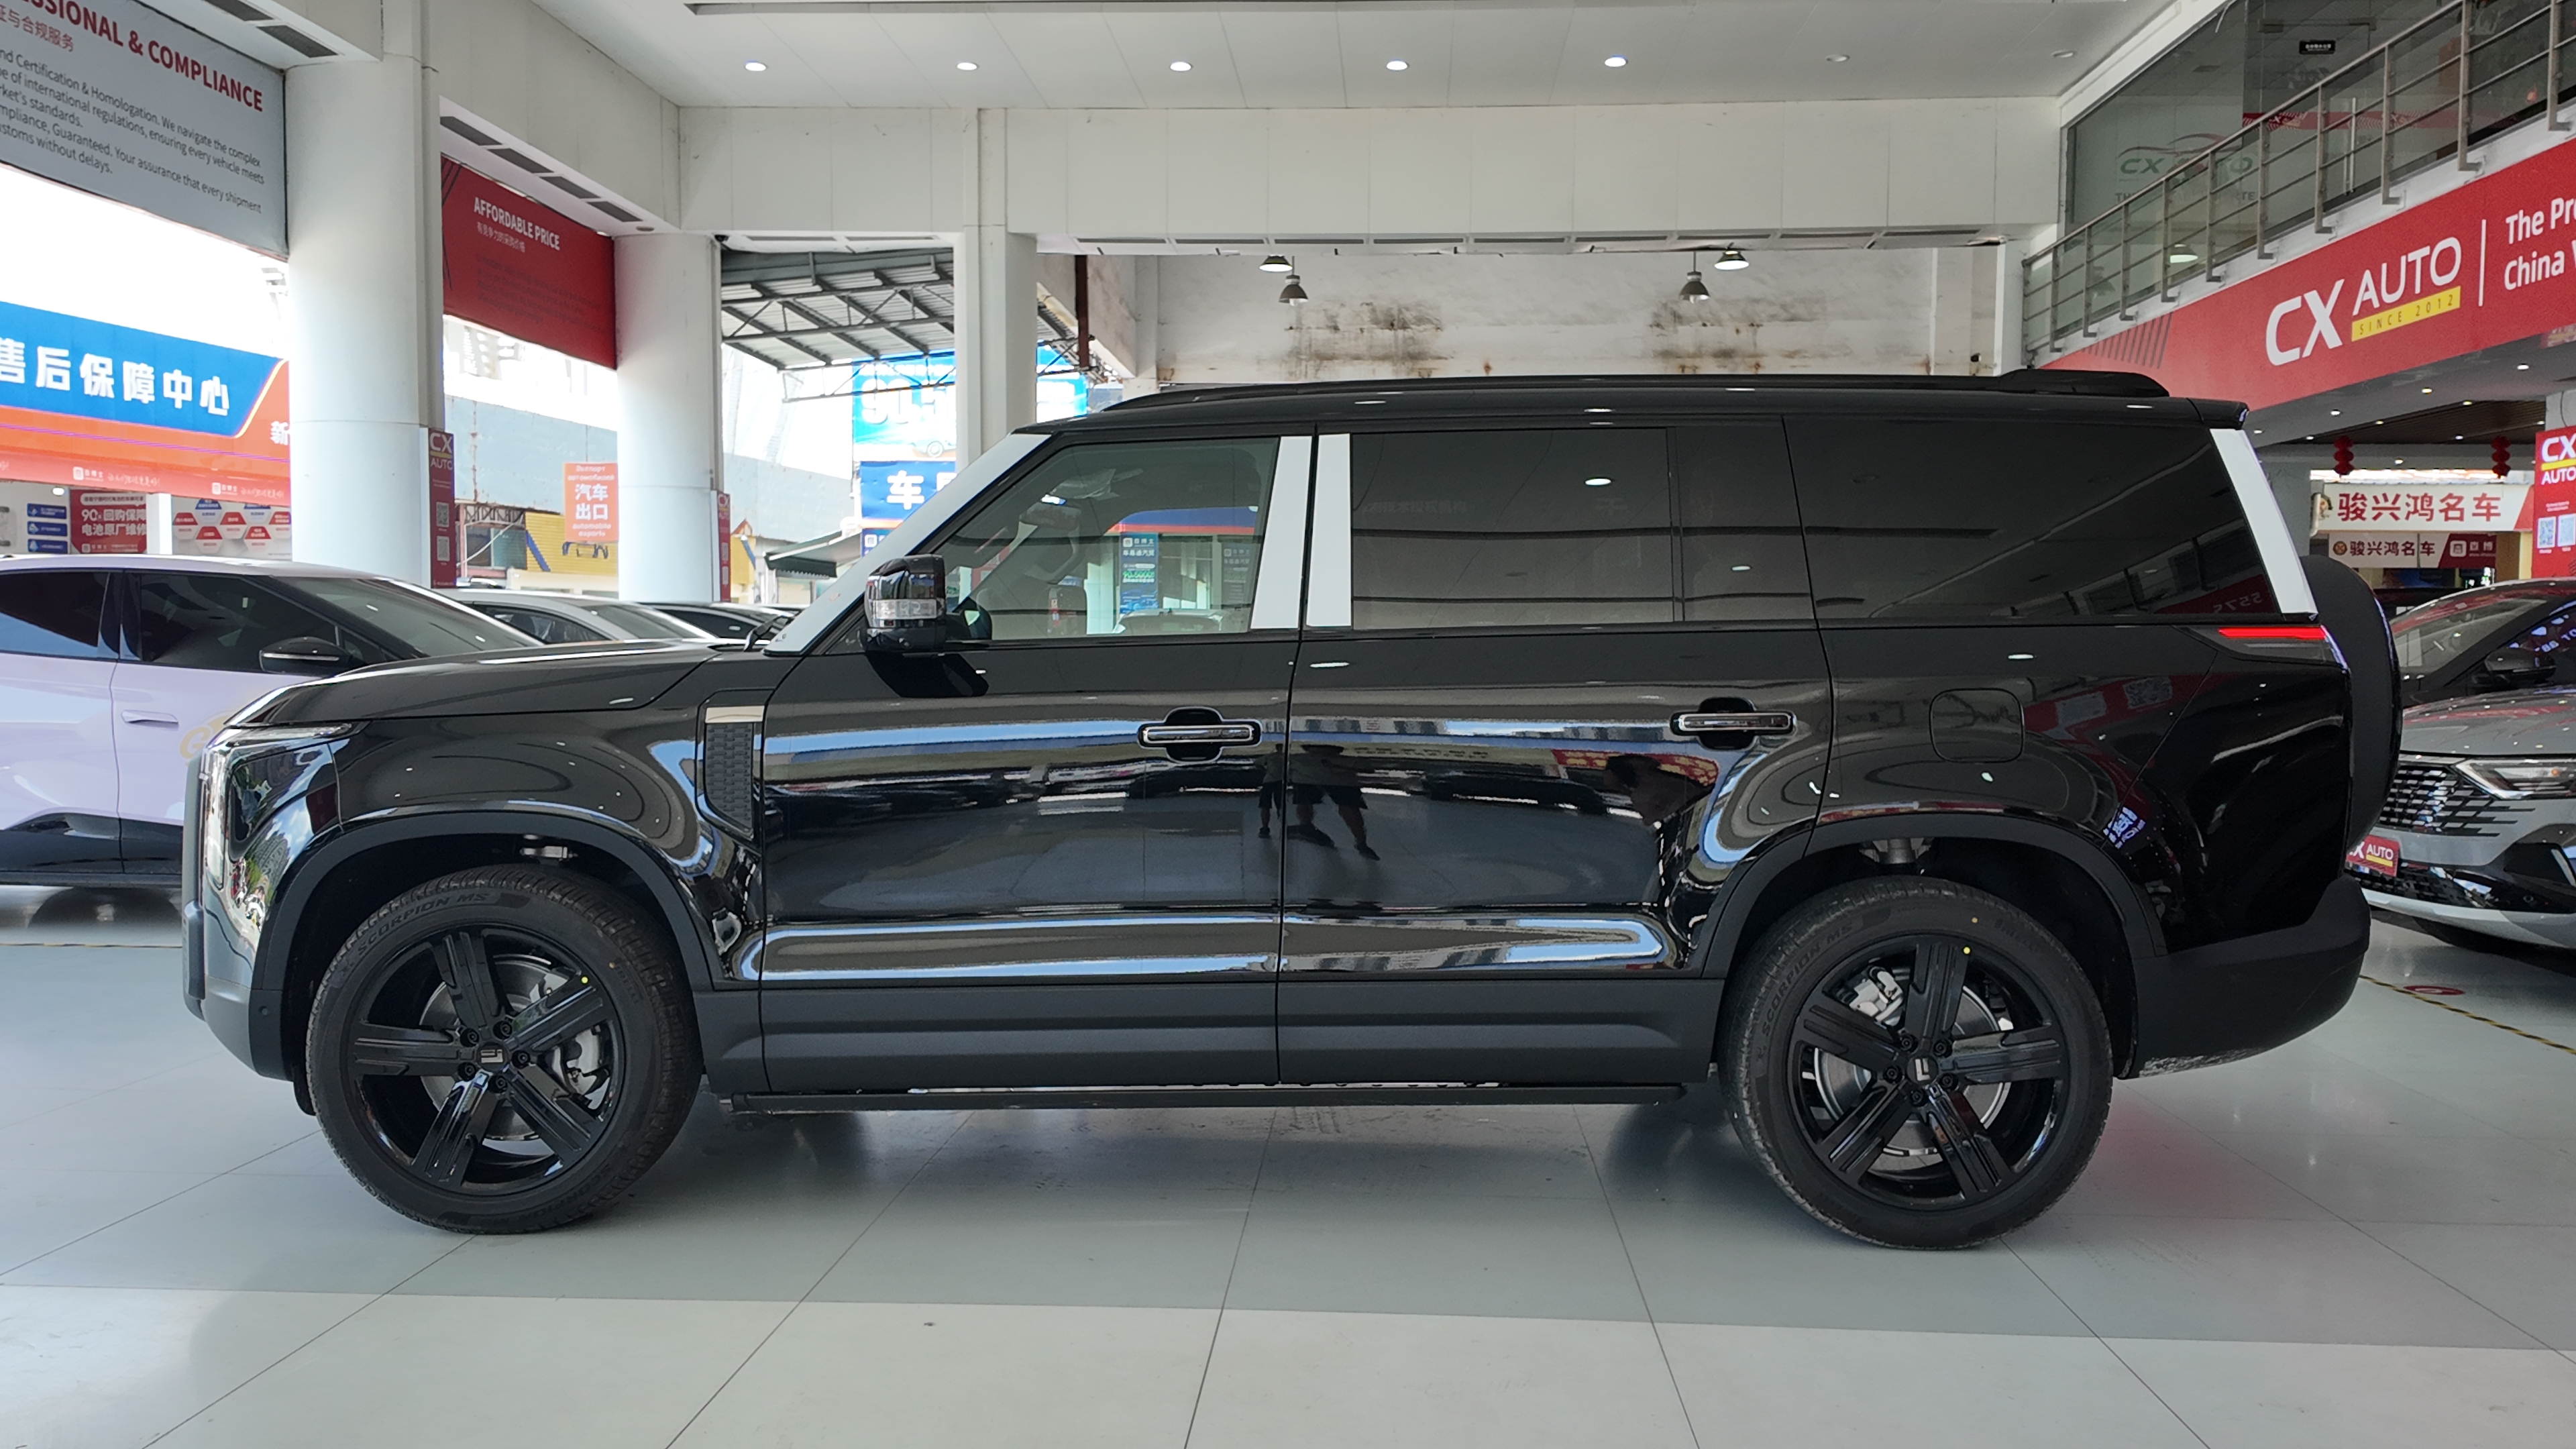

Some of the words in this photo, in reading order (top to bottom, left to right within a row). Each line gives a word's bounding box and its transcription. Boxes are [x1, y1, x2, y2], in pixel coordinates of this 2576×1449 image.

[22, 0, 123, 47] SIONAL
[128, 30, 144, 56] &
[148, 40, 263, 112] COMPLIANCE
[11, 72, 22, 85] of
[24, 74, 91, 113] international
[93, 105, 148, 139] regulations,
[149, 129, 187, 156] ensuring
[189, 146, 211, 165] every
[213, 155, 240, 175] vehicle
[241, 168, 265, 185] meets
[16, 54, 80, 91] Certification
[82, 82, 89, 95] &
[91, 86, 160, 125] Homologation.
[161, 115, 176, 132] We
[177, 125, 212, 147] navigate
[213, 139, 227, 154] the
[229, 146, 261, 168] complex
[30, 97, 83, 127] standards.
[36, 136, 77, 161] without
[79, 151, 113, 174] delays.
[52, 123, 113, 157] Guaranteed.
[115, 146, 136, 164] Your
[138, 158, 182, 184] assurance
[182, 174, 201, 191] that
[202, 183, 224, 202] every
[225, 191, 262, 214] shipment
[2119, 158, 2165, 174] CX
[474, 197, 534, 239] AFFORDABLE
[535, 225, 560, 250] PRICE
[2506, 209, 2544, 244] The
[2504, 250, 2565, 290] China
[2265, 278, 2345, 366] CX
[2352, 236, 2462, 317] AUTO
[2359, 309, 2403, 335] SINCE
[2415, 294, 2454, 318] 2012
[0, 337, 229, 416] 售后保障中心
[430, 432, 452, 453] CX
[2541, 432, 2576, 463] CX
[431, 457, 453, 471] AUTO
[2541, 466, 2576, 485] AUTO
[575, 483, 608, 501] 汽车
[2337, 492, 2502, 522] 骏兴鸿名车
[576, 502, 608, 521] 出口
[2349, 541, 2436, 557] 骏兴鸿名车
[2349, 841, 2365, 859] X
[2366, 843, 2394, 861] AUTO
[358, 896, 451, 957] SCORPION
[456, 892, 490, 903] MS
[1762, 942, 1821, 1036] SCORPION
[1826, 924, 1853, 945] MS
